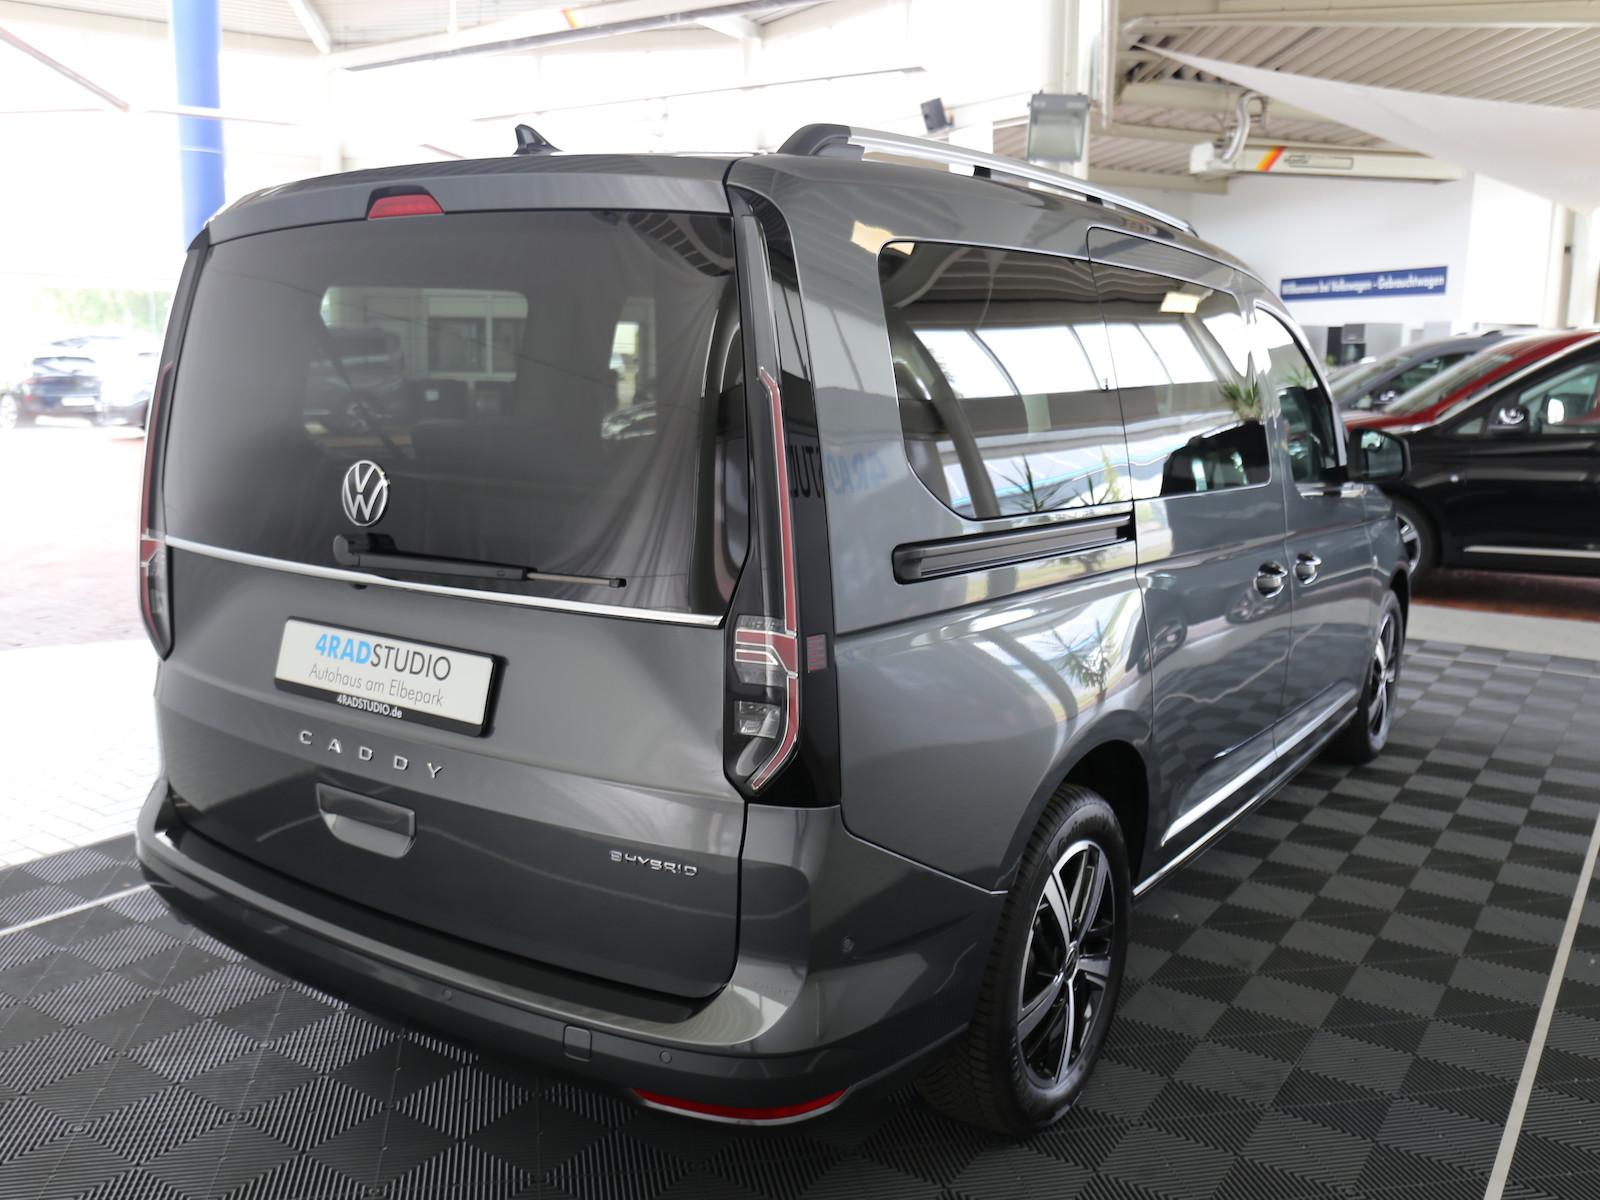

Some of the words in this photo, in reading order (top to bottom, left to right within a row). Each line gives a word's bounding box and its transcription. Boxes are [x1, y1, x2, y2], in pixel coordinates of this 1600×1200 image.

[342, 460, 388, 526] VW
[315, 633, 451, 681] 4RADSTUDIO
[309, 663, 362, 689] Autohaus
[365, 679, 385, 694] am
[388, 679, 444, 707] Elbepark
[337, 694, 403, 718] 4RADSTUDIO.de
[300, 730, 443, 778] CADDY
